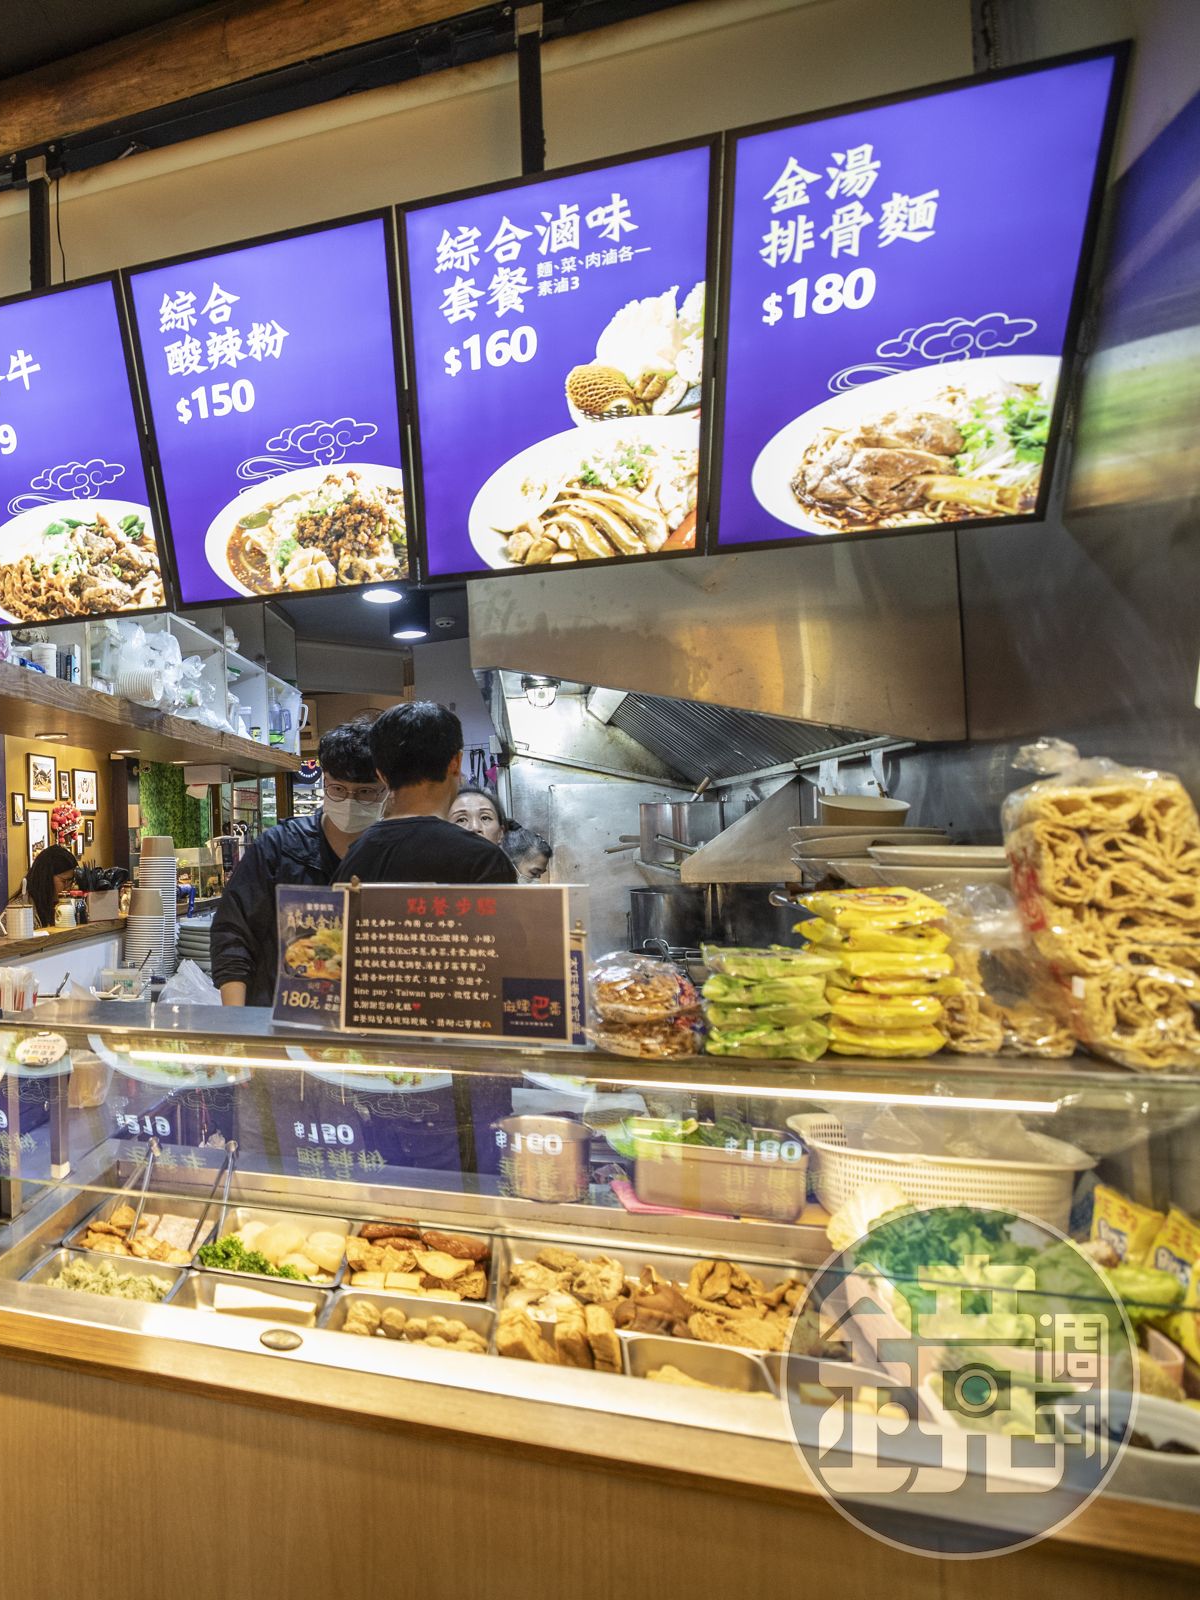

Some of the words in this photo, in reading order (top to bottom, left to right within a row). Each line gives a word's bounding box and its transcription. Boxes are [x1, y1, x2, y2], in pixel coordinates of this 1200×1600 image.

[762, 143, 882, 214] 金湯
[434, 193, 639, 274] 綜合滷味
[758, 189, 940, 268] 排骨麵
[158, 281, 241, 334] 綜合
[439, 266, 535, 325] 套餐
[537, 276, 580, 297] 素滷3
[761, 267, 877, 326] $180
[165, 318, 290, 378] 酸辣粉
[443, 325, 538, 377] $160
[175, 378, 256, 425] $150
